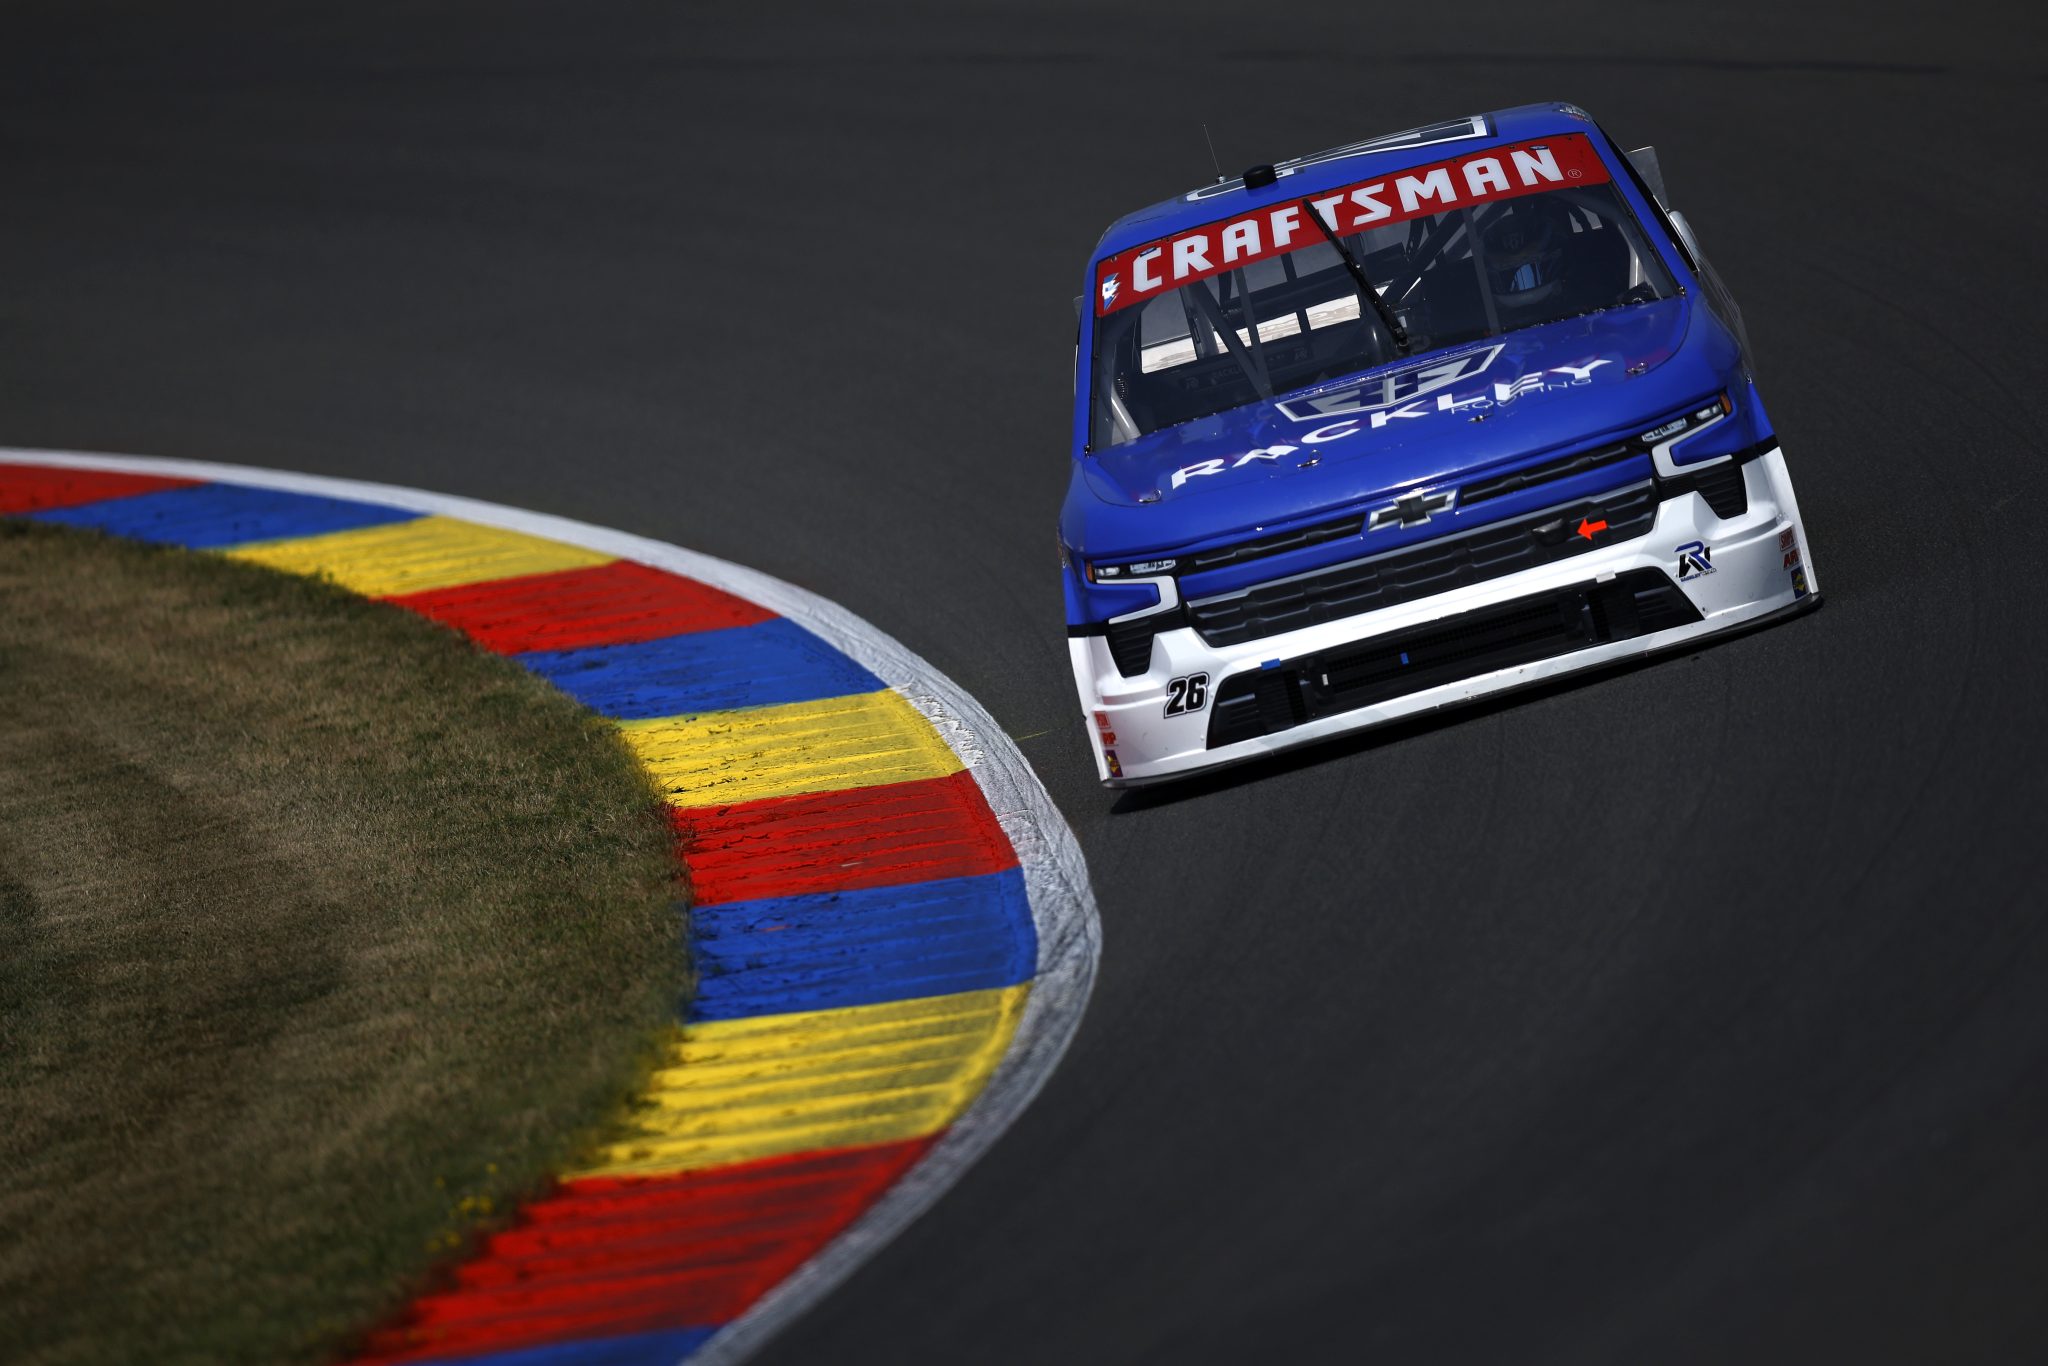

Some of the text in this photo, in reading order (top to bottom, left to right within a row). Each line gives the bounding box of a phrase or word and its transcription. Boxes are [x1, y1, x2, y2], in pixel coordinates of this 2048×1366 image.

[1133, 148, 1564, 293] CRAFTSMAN
[1171, 359, 1613, 490] RACKLEY
[1163, 671, 1210, 719] 26
